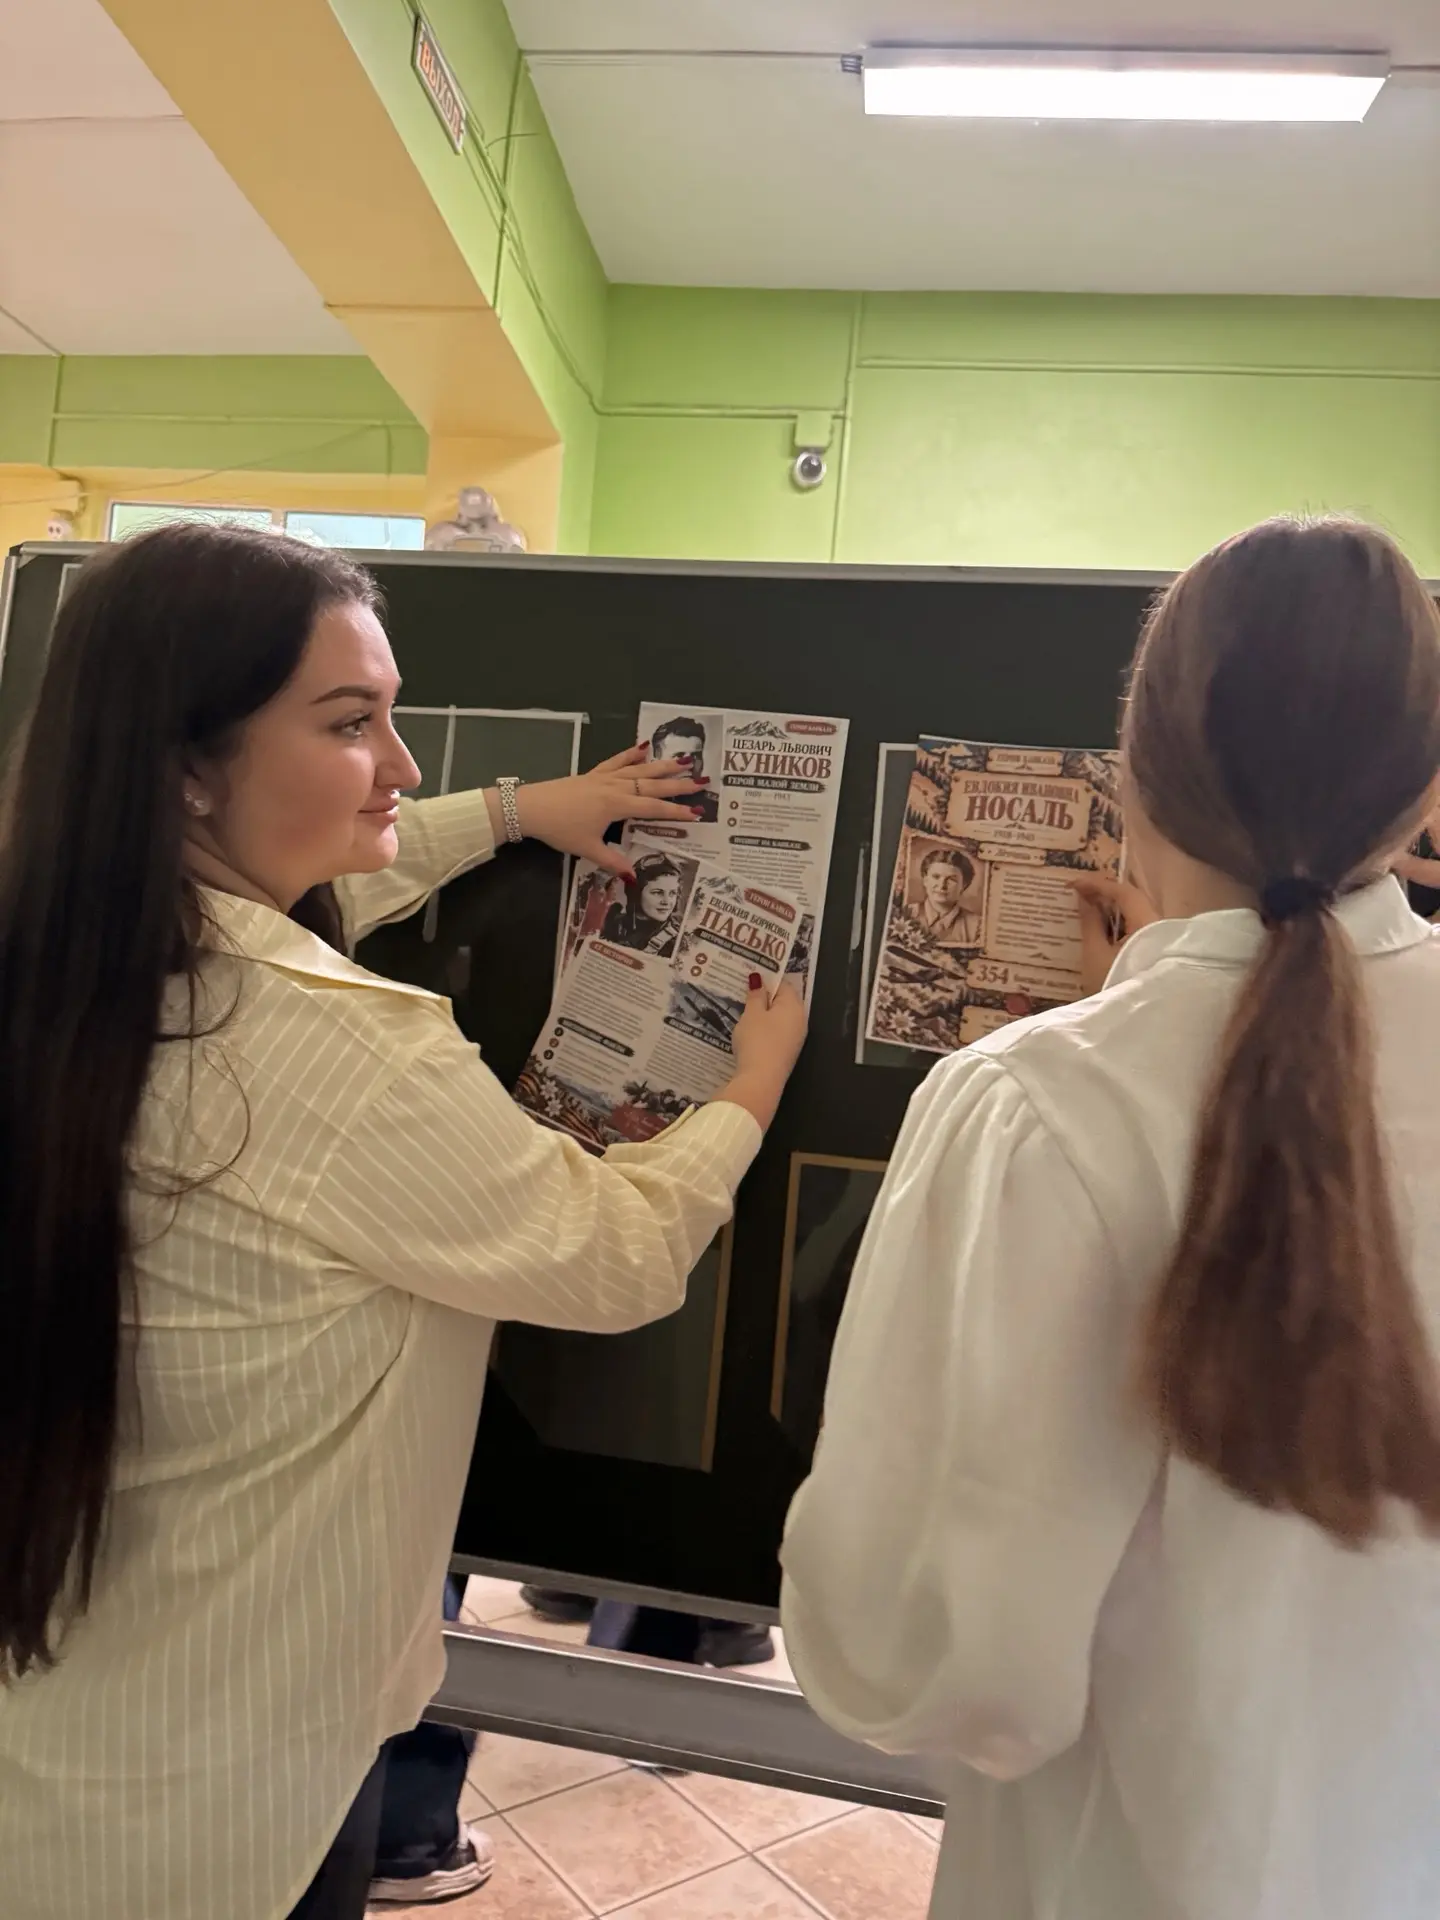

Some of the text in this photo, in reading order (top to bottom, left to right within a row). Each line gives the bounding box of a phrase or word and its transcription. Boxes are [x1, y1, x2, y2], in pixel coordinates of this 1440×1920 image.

[732, 738, 832, 756] ЦЕЗАРЬ ЛЬВОВИЧ
[723, 750, 832, 779] КУНИКОВ
[728, 776, 819, 792] ГЕРОЙ МАЛОЙ ЗЕМЛИ
[964, 780, 1019, 794] ЕВДОКИЯ
[964, 795, 1074, 830] НОСАЛЬ
[709, 896, 750, 919] ЕВДОКИЯ
[699, 906, 786, 962] ПАСЬКО
[976, 963, 1009, 985] 354
